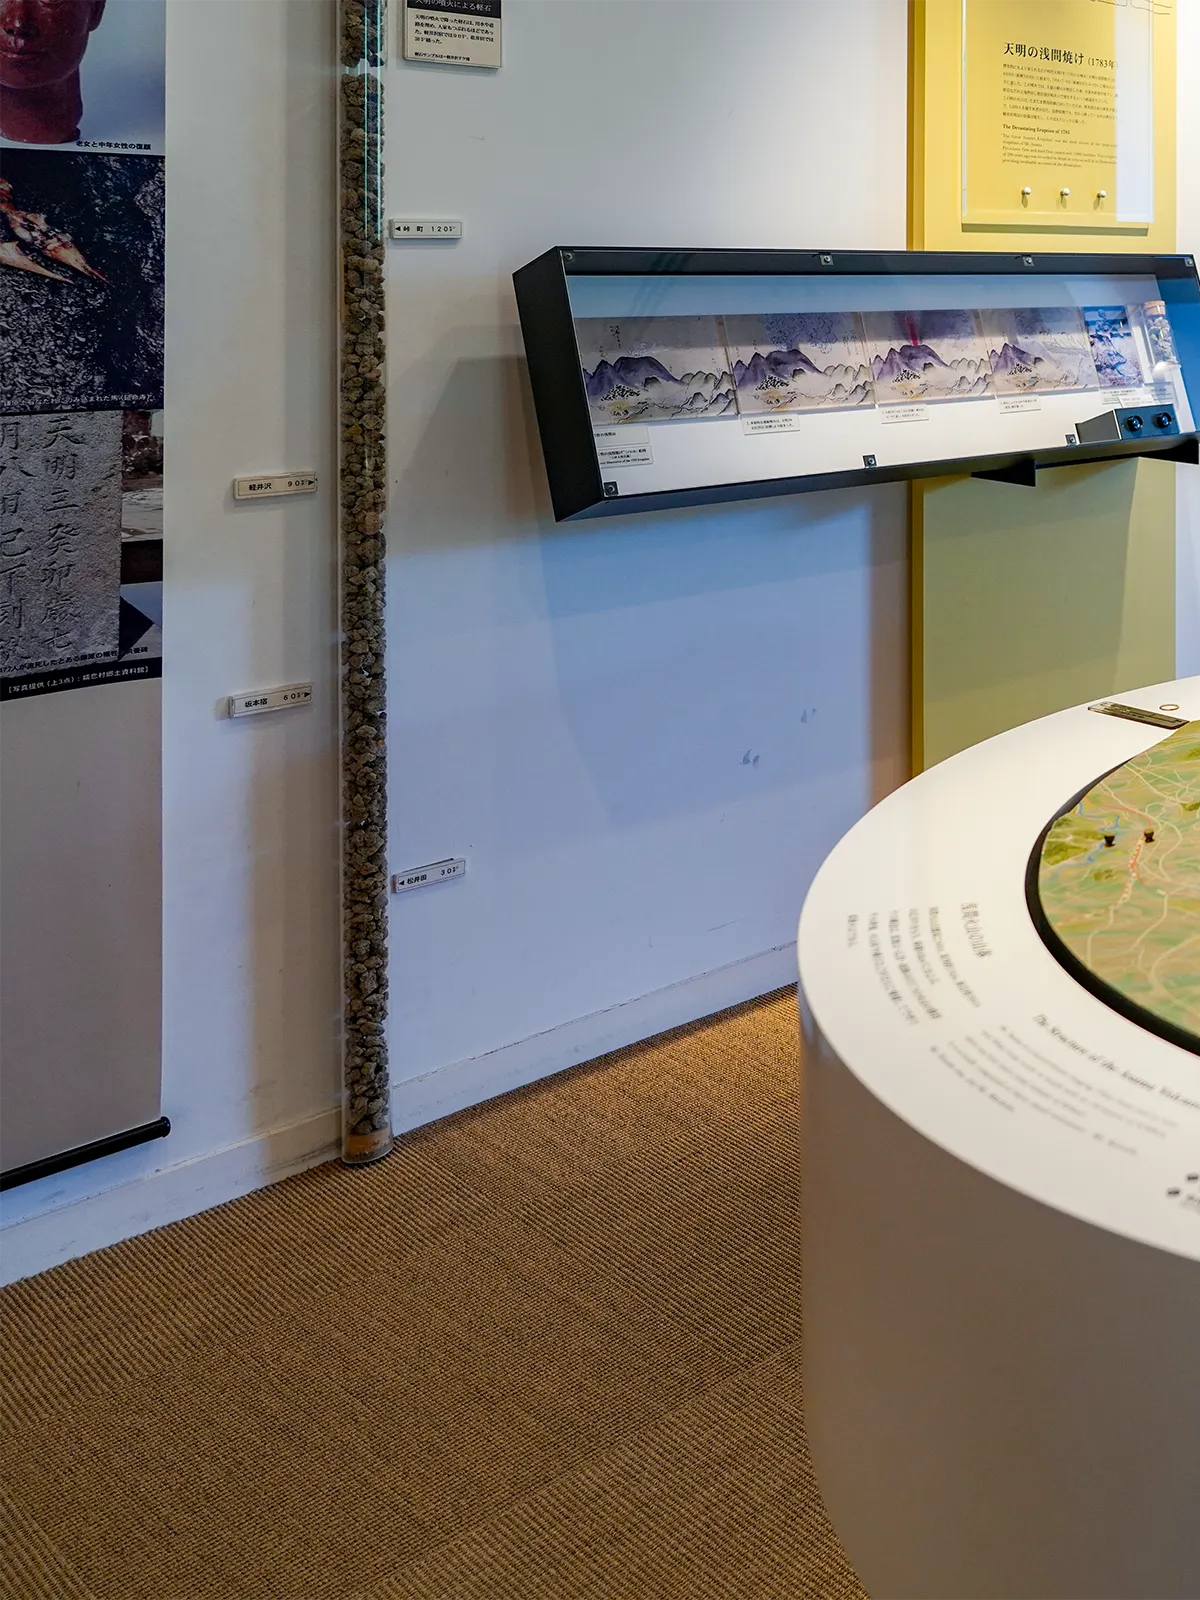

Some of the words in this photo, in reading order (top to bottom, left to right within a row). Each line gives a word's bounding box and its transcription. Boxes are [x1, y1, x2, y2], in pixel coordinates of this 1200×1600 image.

[1003, 42, 1084, 65] 天明の浅間焼け
[1012, 125, 1036, 133] Devastating
[76, 140, 152, 150] 老女と中年女性の復顔
[249, 482, 272, 491] 軽井沢
[244, 698, 268, 708] 坂本宿
[407, 873, 427, 884] 松井田
